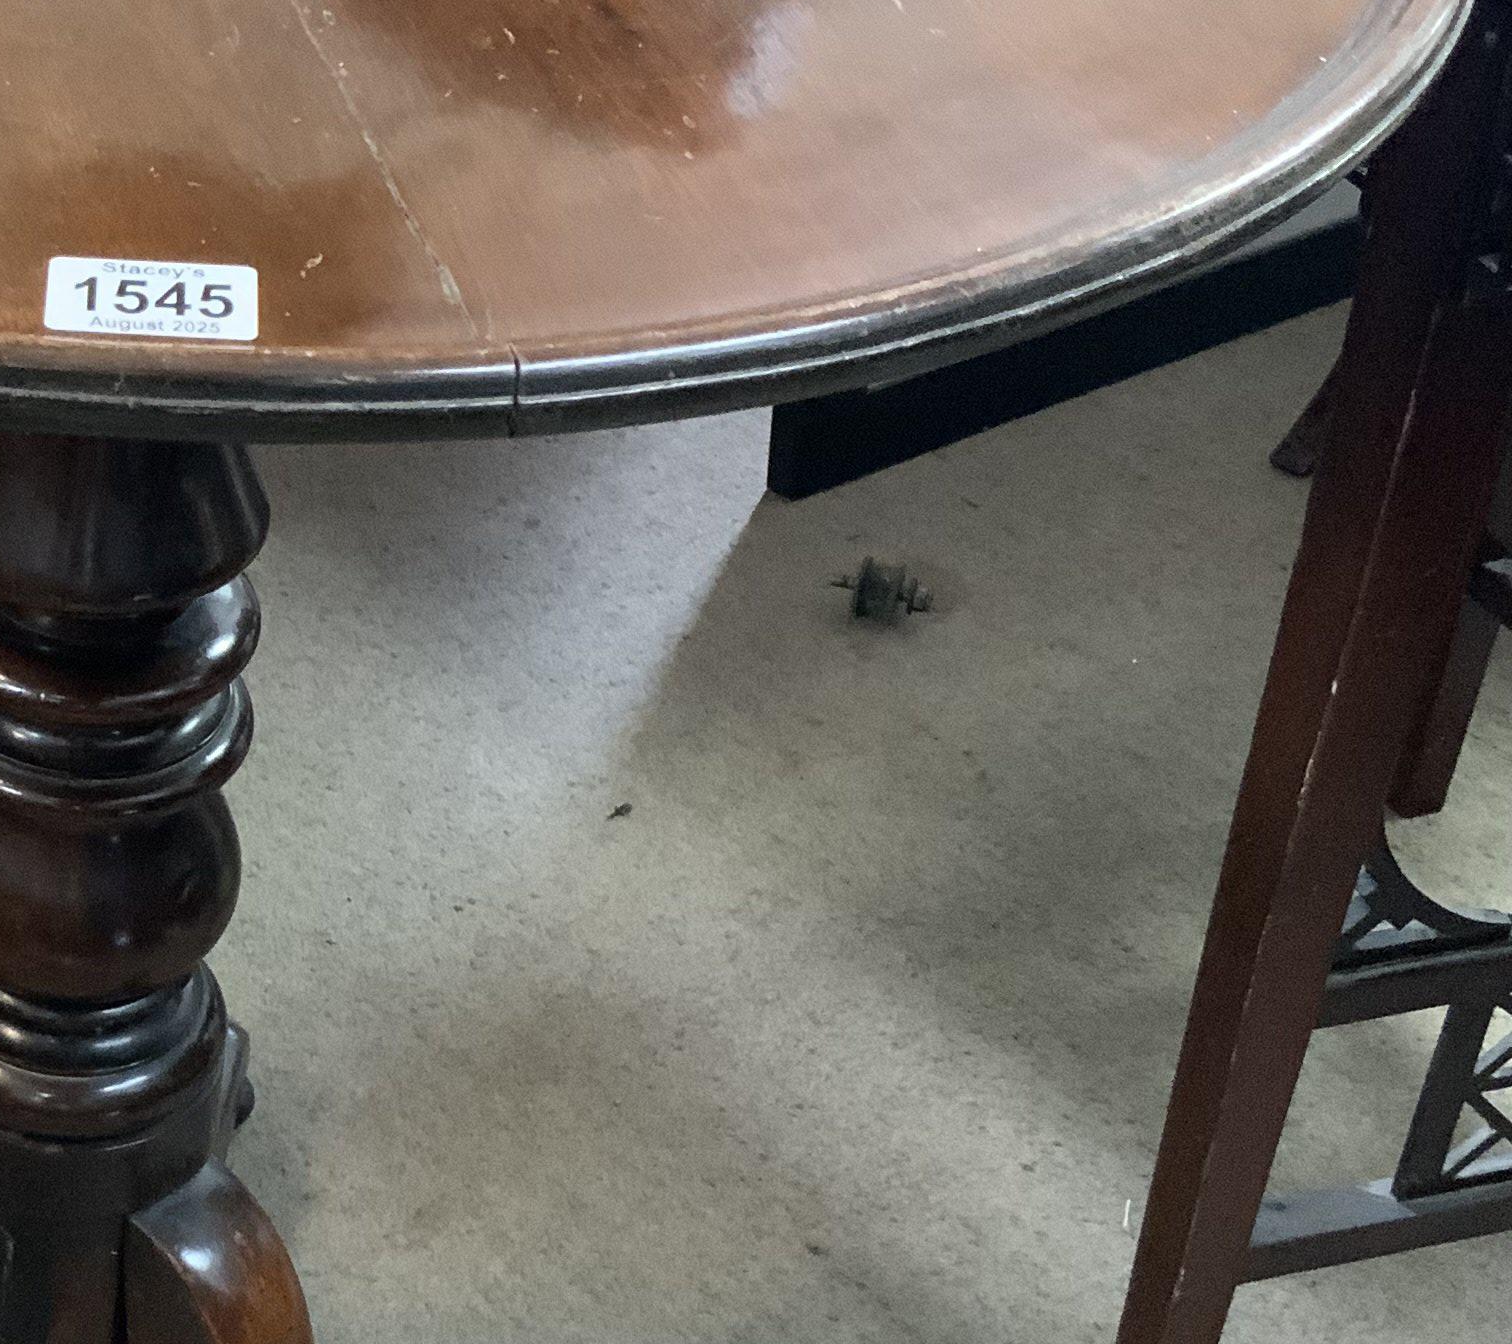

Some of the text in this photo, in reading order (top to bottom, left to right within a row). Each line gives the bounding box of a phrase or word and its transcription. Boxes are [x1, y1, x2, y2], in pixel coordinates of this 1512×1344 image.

[101, 261, 206, 279] Stacey's
[74, 276, 234, 318] 1545
[89, 316, 221, 334] August 2025
